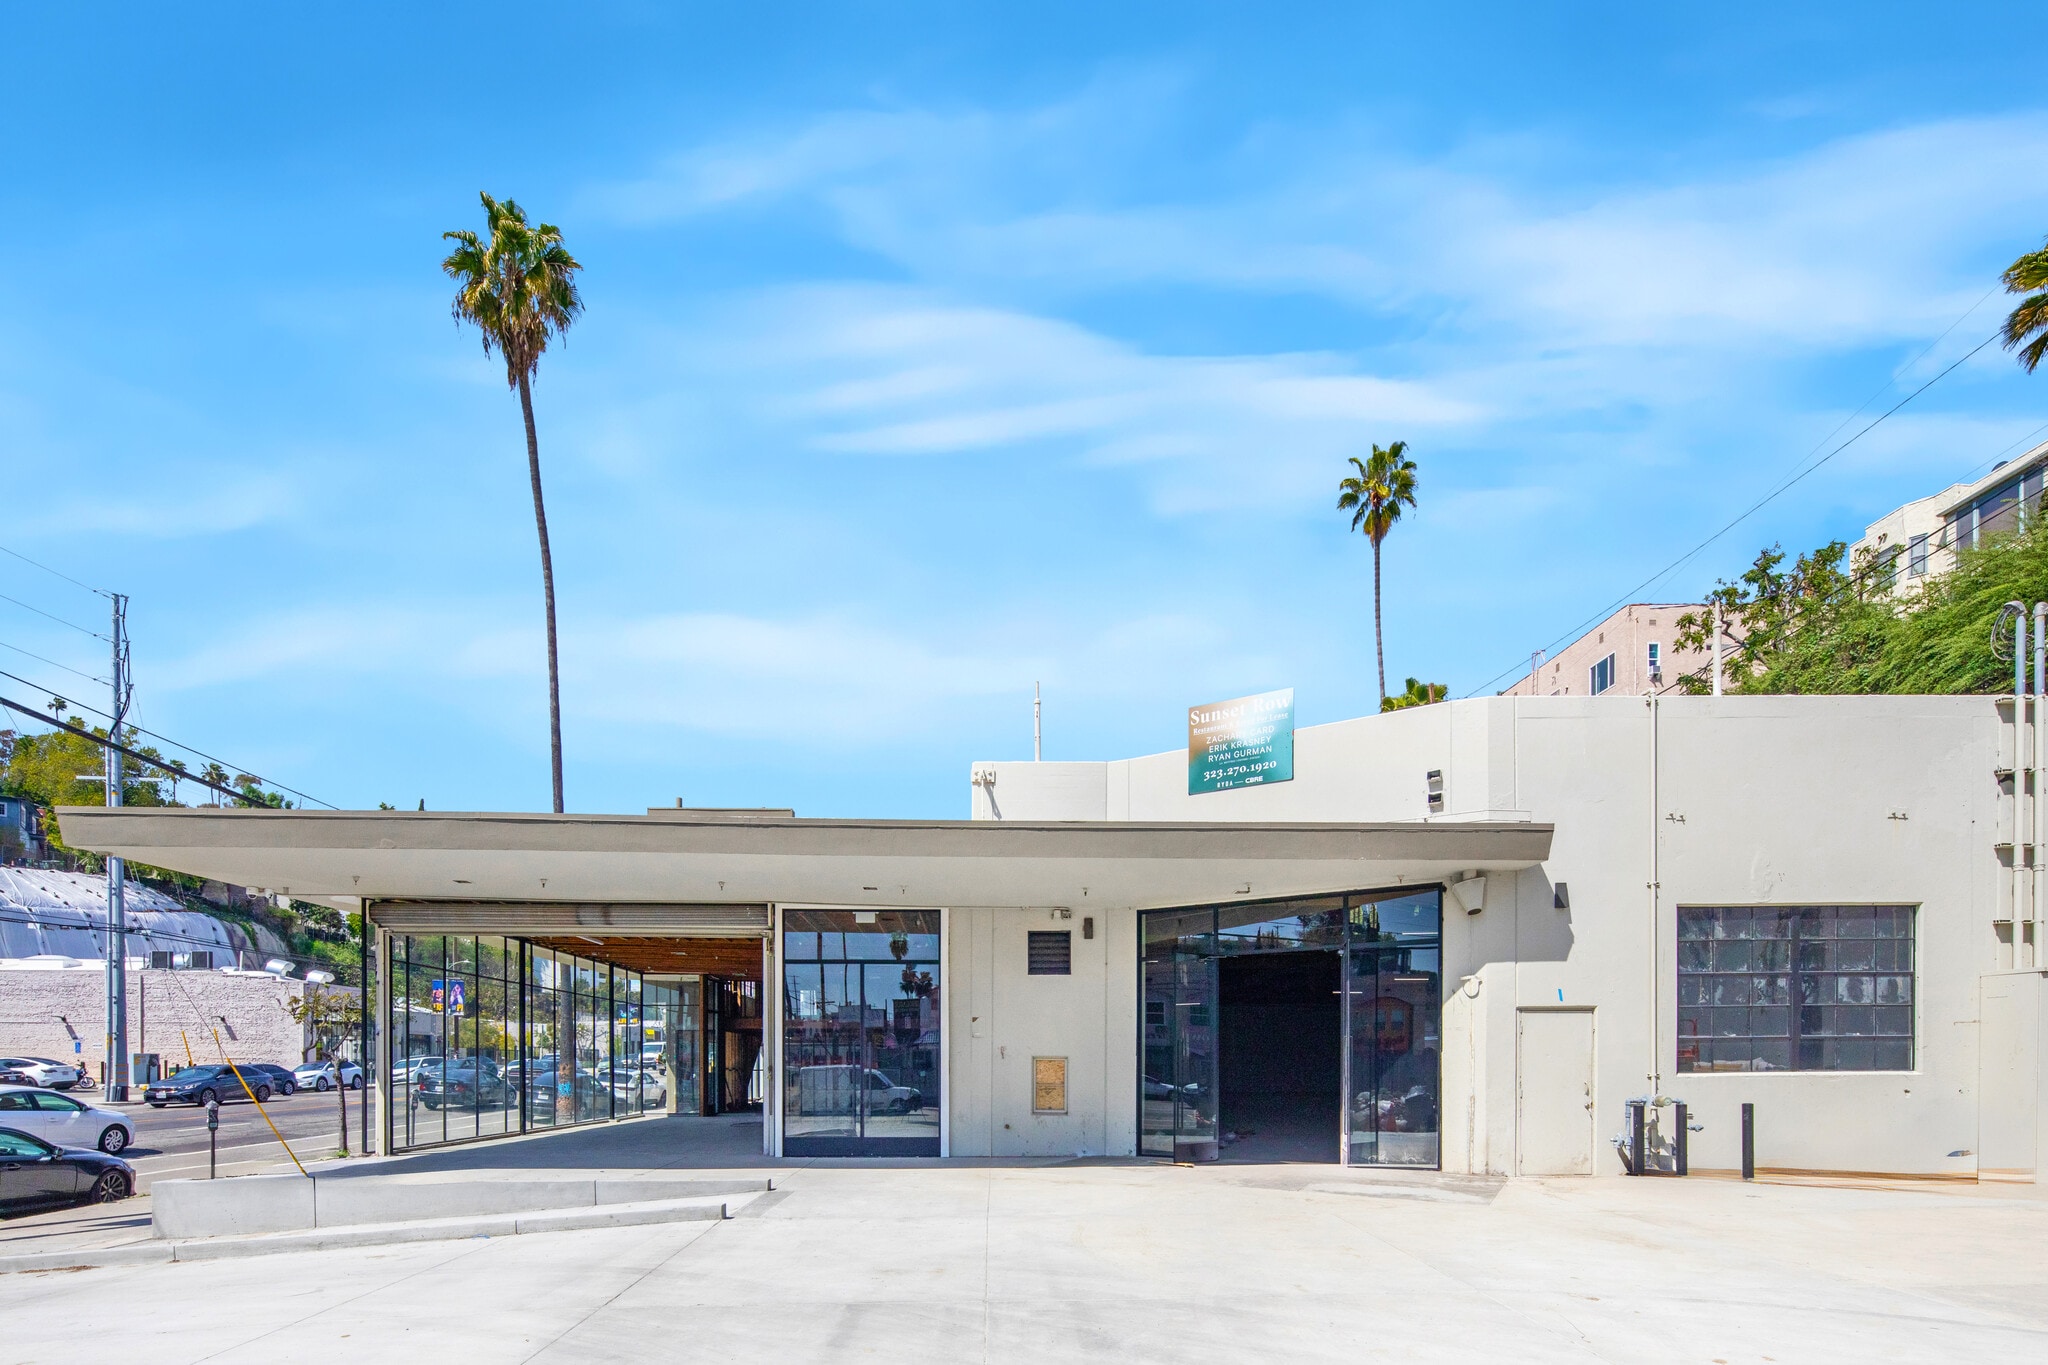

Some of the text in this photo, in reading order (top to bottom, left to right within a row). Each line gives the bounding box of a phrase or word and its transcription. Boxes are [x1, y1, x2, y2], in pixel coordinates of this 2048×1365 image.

[1190, 704, 1244, 726] Sunset
[1253, 695, 1291, 711] Row
[1249, 725, 1275, 737] CARD
[1208, 735, 1272, 753] ERIK KRASNEY
[1208, 752, 1231, 763] RYAN
[1233, 745, 1272, 758] GURMAN
[1203, 760, 1277, 781] 323.270.1920
[1244, 775, 1264, 784] CBRE
